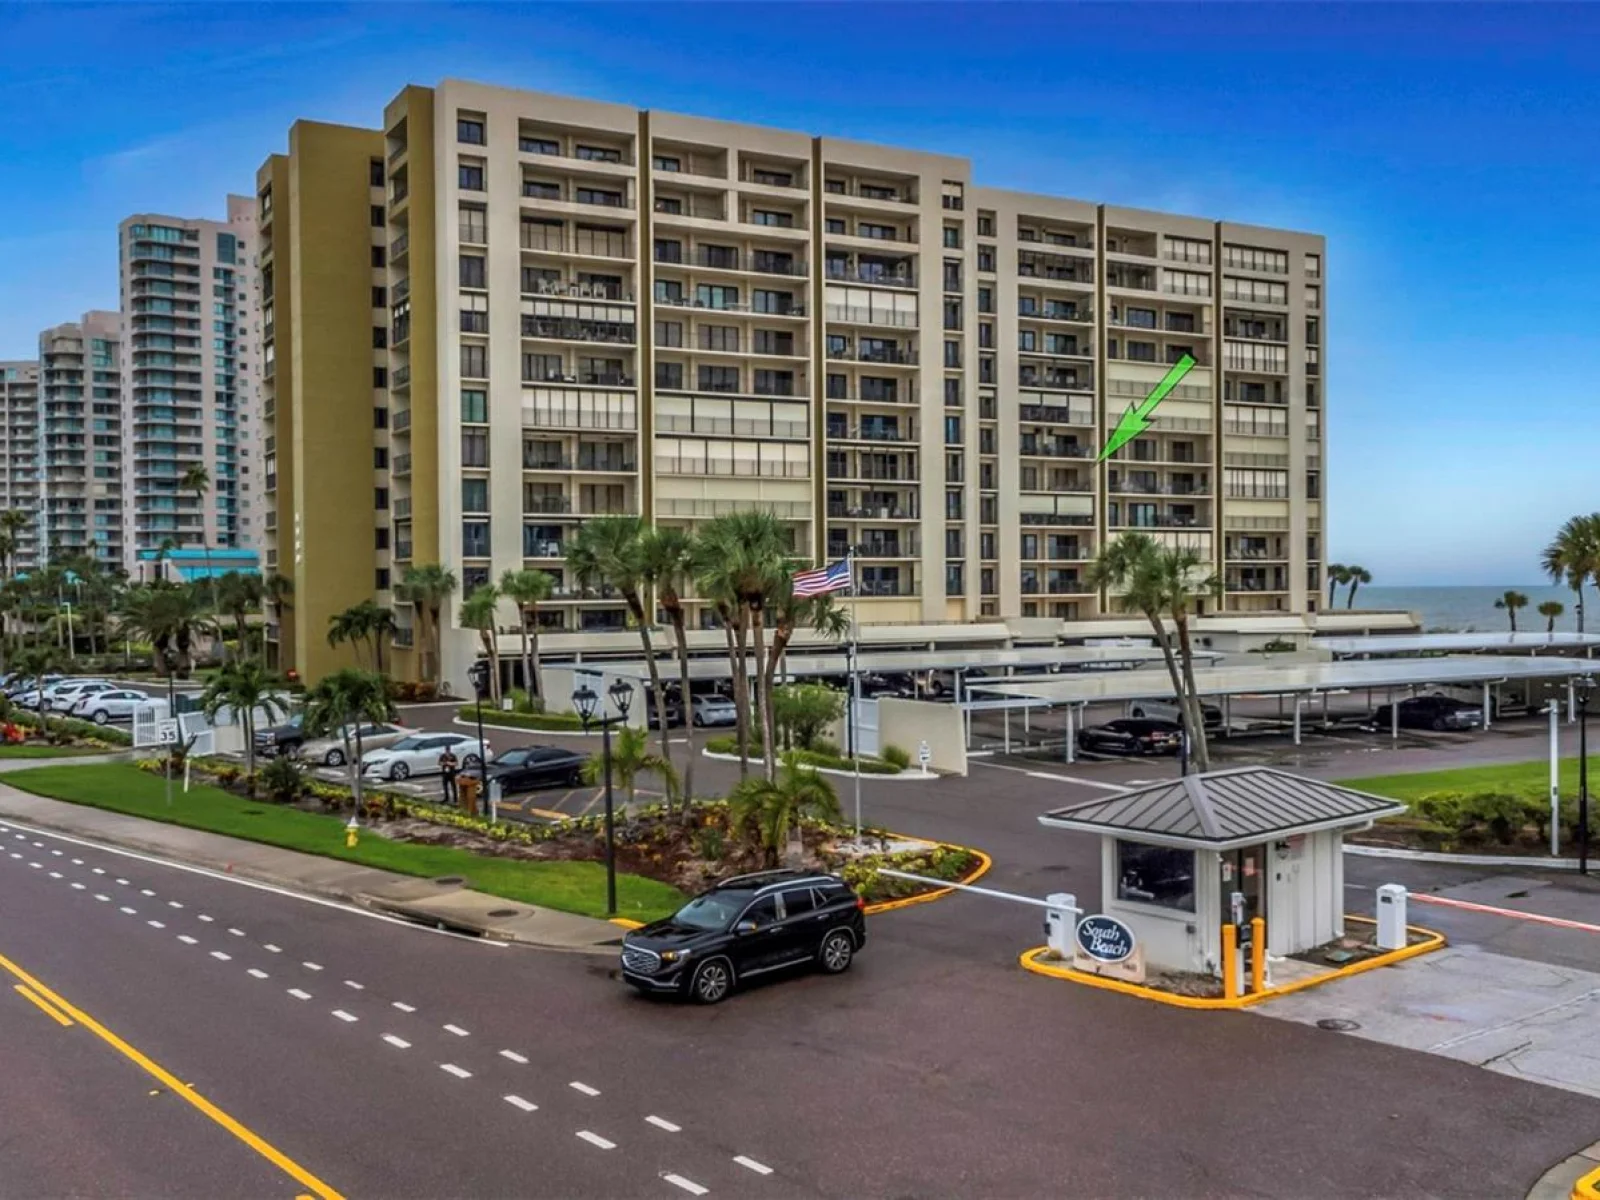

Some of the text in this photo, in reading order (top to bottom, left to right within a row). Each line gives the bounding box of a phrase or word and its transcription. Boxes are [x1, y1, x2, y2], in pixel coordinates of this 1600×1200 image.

[160, 731, 176, 741] 35
[1082, 920, 1120, 941] South
[1089, 937, 1128, 956] Beach
